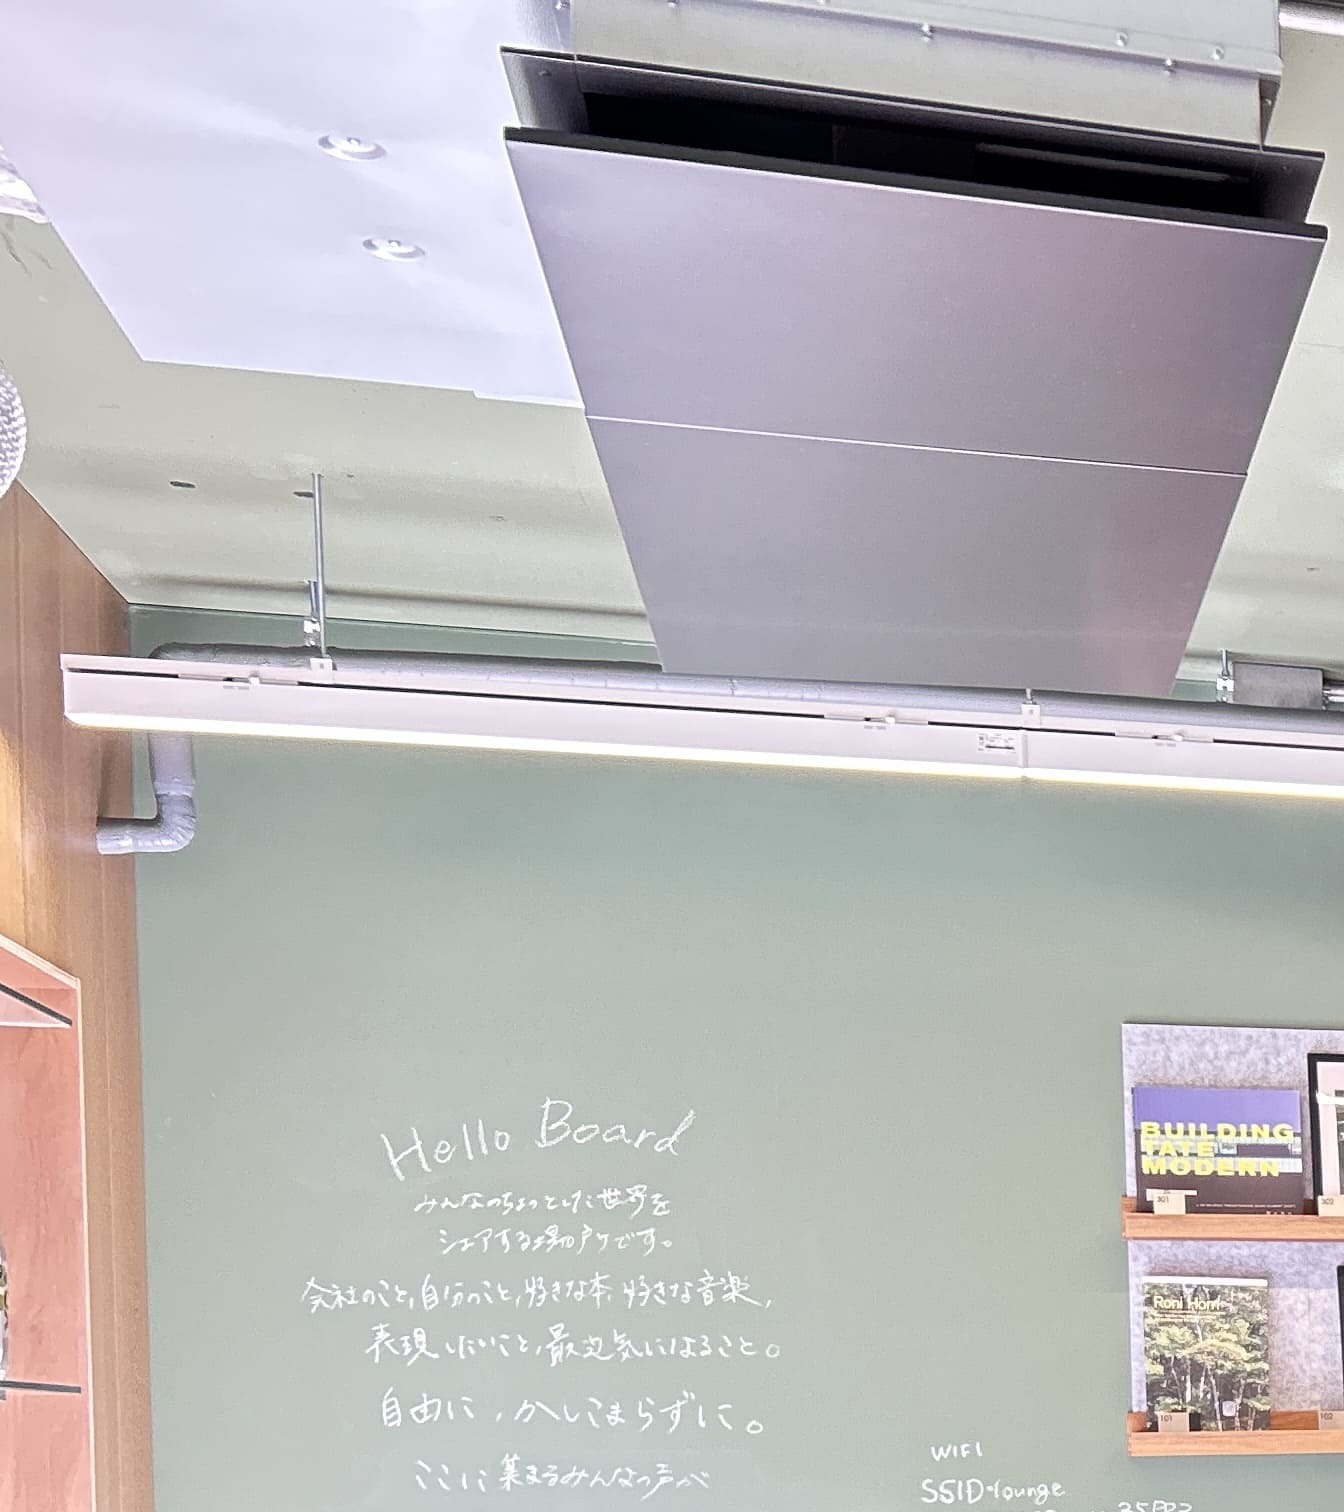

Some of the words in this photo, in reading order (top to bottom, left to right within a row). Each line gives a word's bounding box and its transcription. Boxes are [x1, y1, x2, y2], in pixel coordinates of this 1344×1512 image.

[1140, 1121, 1294, 1139] BUILDING
[380, 1118, 510, 1181] Hello
[534, 1096, 697, 1157] Board
[1140, 1140, 1216, 1157] TATE
[1141, 1157, 1280, 1176] MODERN
[1156, 1195, 1169, 1203] 301
[1321, 1198, 1334, 1206] 302
[1153, 1296, 1184, 1309] Roni
[1160, 1414, 1173, 1422] 101
